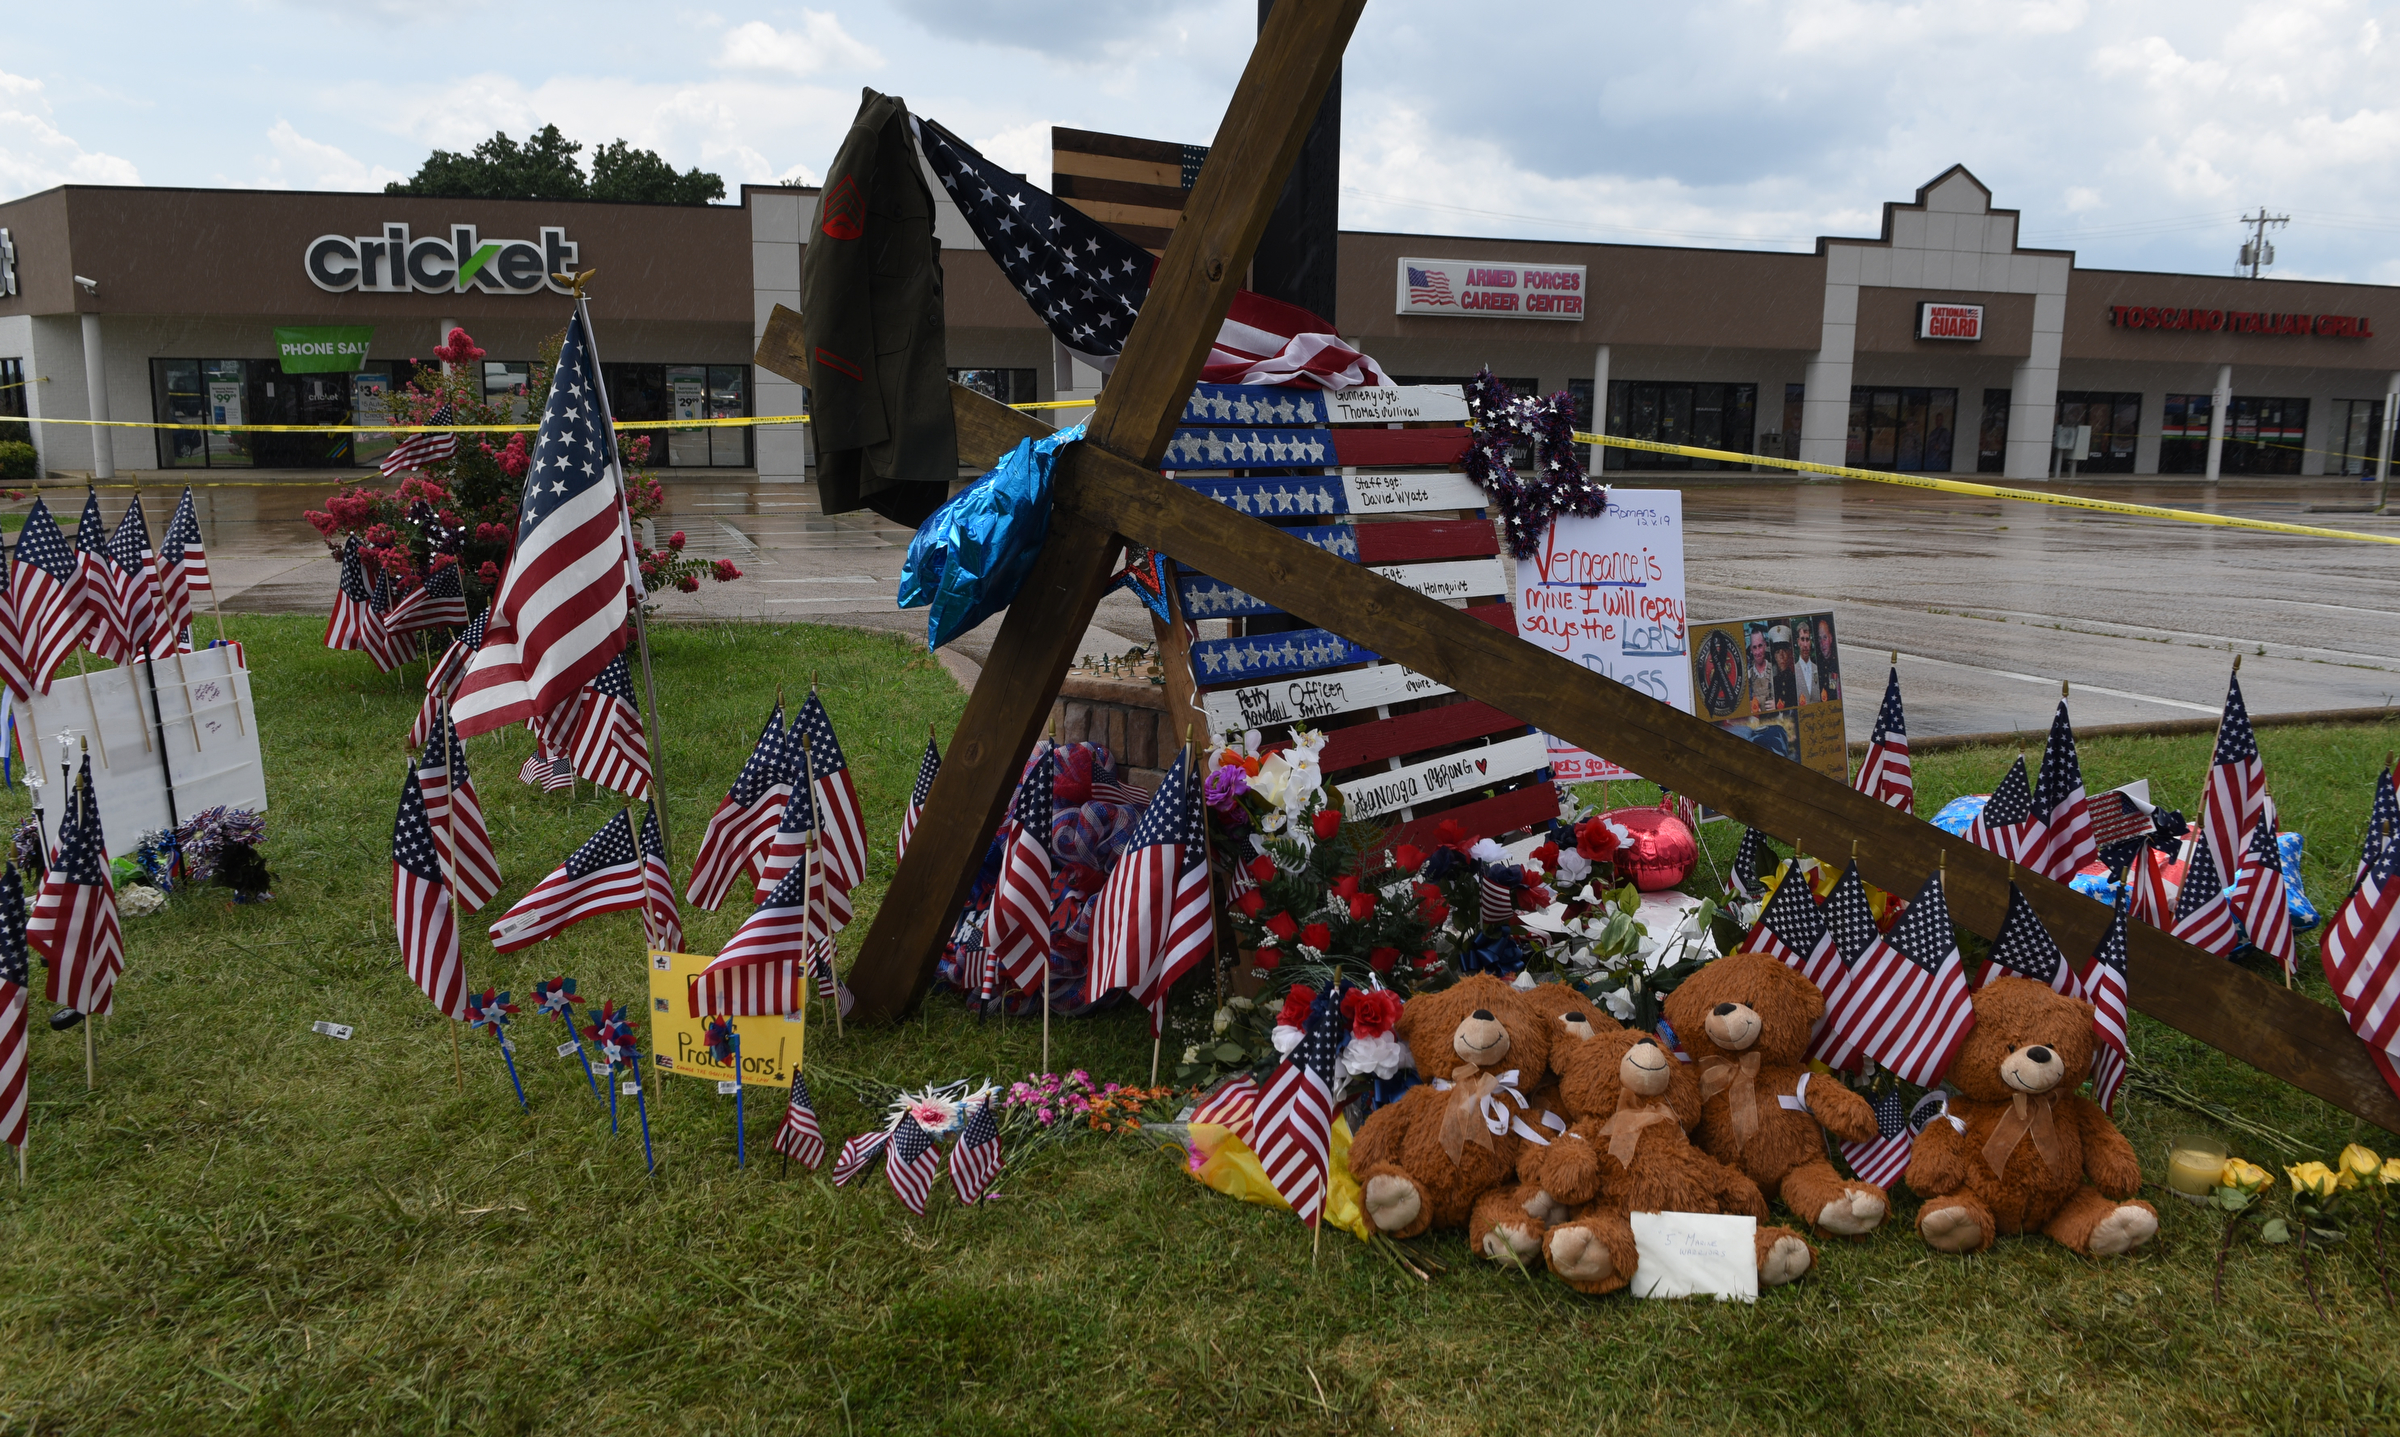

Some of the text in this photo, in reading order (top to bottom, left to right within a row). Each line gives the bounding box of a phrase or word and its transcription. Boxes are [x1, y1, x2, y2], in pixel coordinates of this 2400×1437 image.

[307, 223, 577, 293] cricket
[1466, 268, 1580, 290] ARMED FORCES
[1461, 291, 1582, 313] CAREER CENTER
[1931, 306, 1968, 318] NATIONAL
[1929, 316, 1978, 337] GUARD
[2113, 305, 2374, 338] TOSCANO ITALIAN GRILL
[281, 343, 334, 356] PHONE
[1643, 547, 1663, 581] is
[1522, 615, 1580, 652] says
[1581, 617, 1616, 642] the
